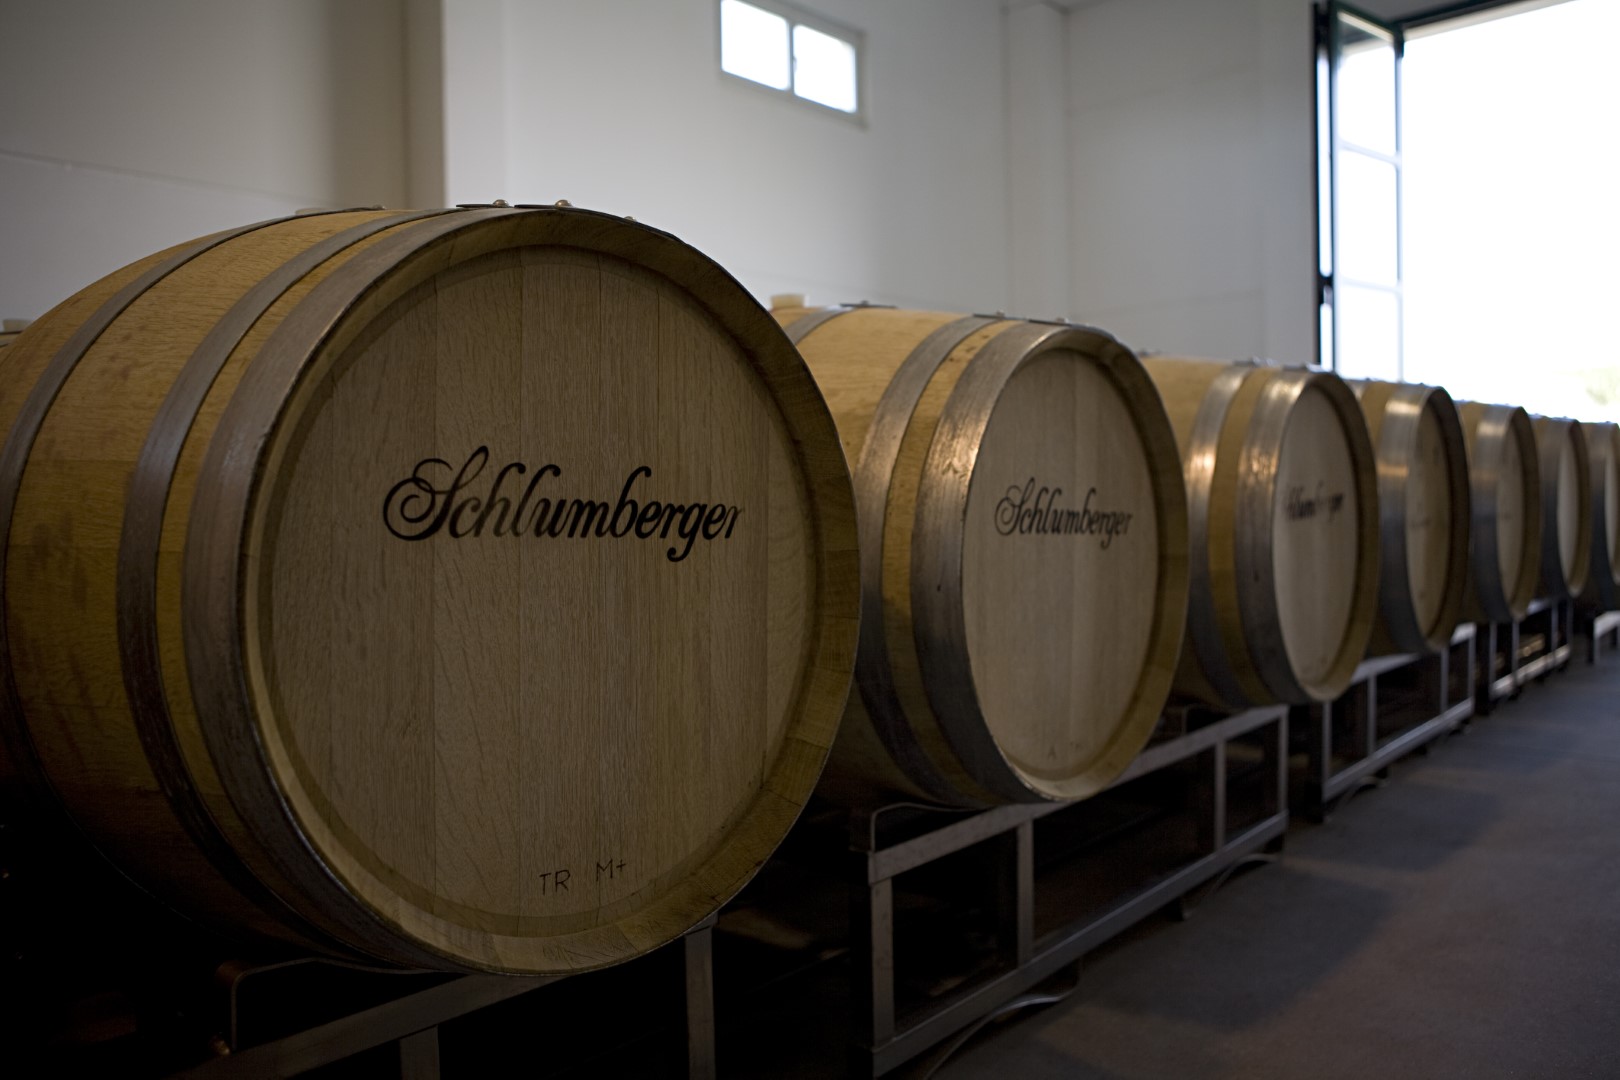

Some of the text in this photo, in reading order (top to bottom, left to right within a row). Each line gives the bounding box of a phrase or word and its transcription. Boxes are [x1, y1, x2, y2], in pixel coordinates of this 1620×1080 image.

[383, 445, 742, 562] Schlumberger
[995, 477, 1133, 550] Schlumberger
[539, 869, 571, 896] TR
